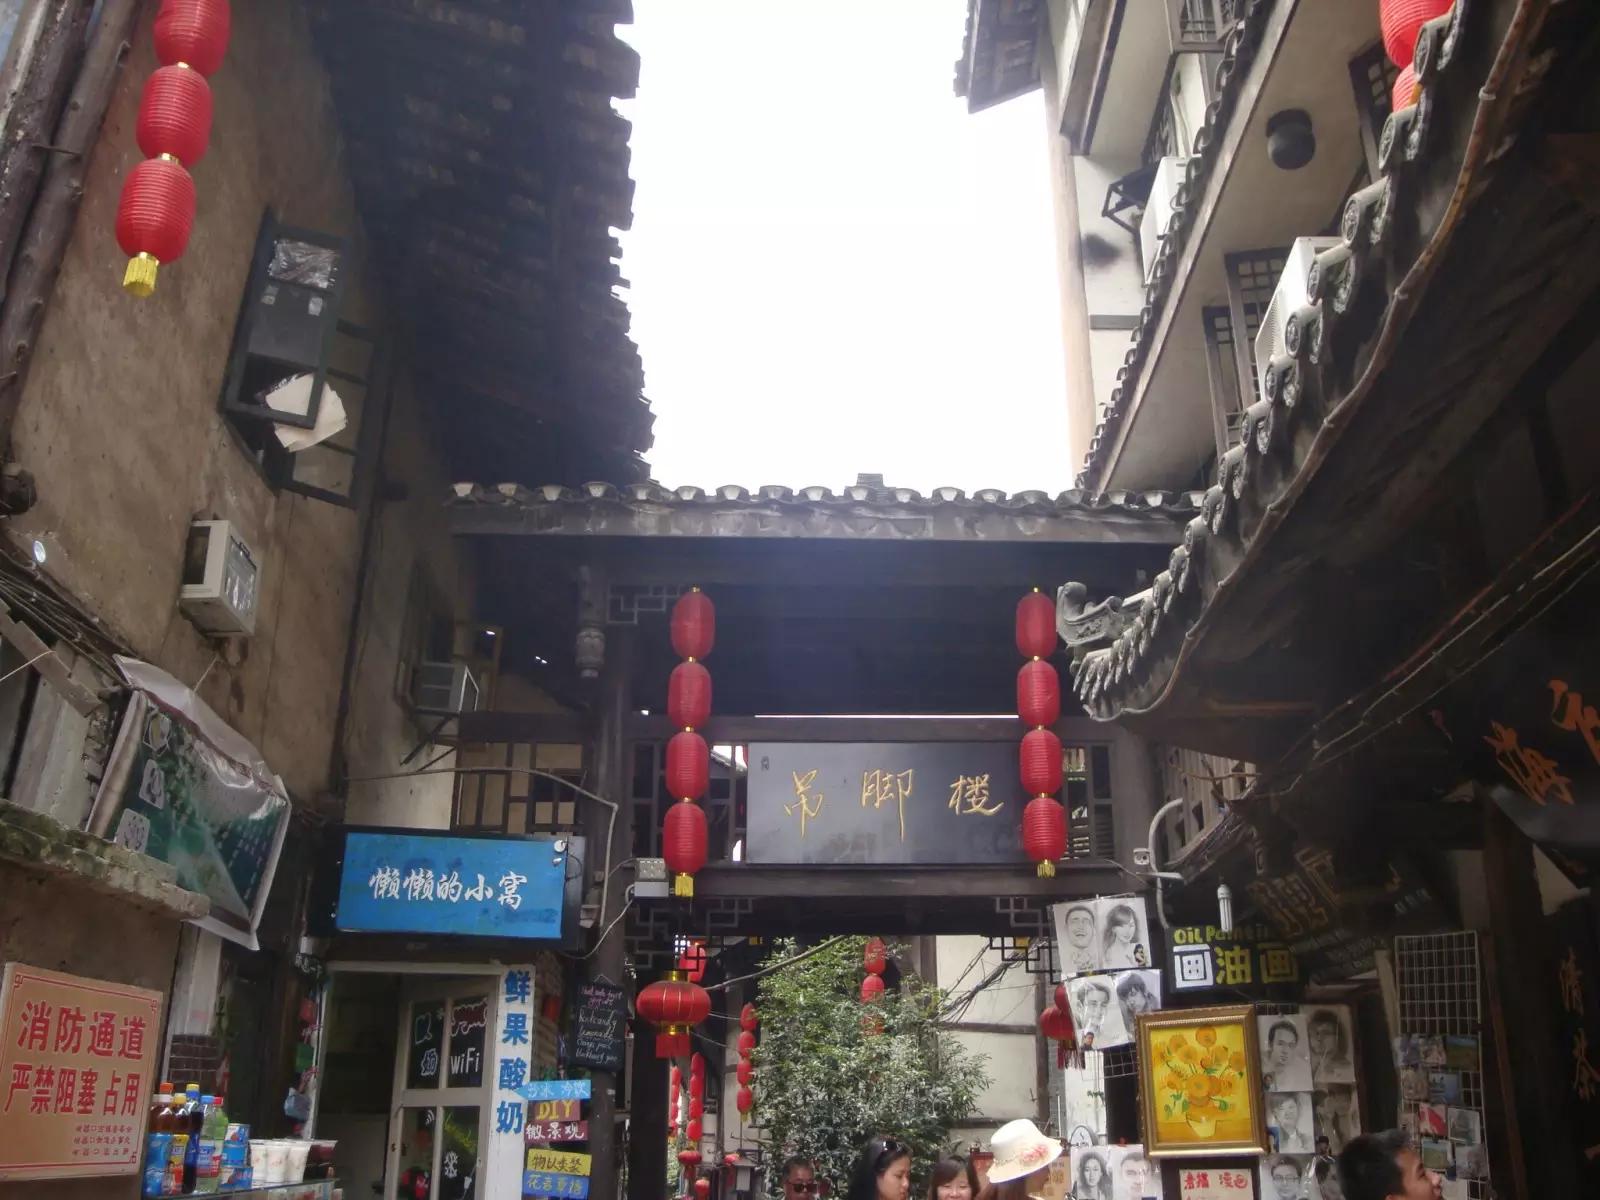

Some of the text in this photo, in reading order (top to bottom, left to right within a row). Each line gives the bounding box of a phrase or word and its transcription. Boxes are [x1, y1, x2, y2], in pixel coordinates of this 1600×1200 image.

[784, 769, 1004, 843] 吊脚楼
[368, 865, 528, 911] 懒懒的小窝
[17, 1000, 146, 1060] 消防通道
[496, 969, 532, 1135] 鲜果酸奶
[4, 1063, 141, 1117] 严禁阻塞占用
[536, 1100, 574, 1120] DIY
[525, 1121, 585, 1140] 微景观
